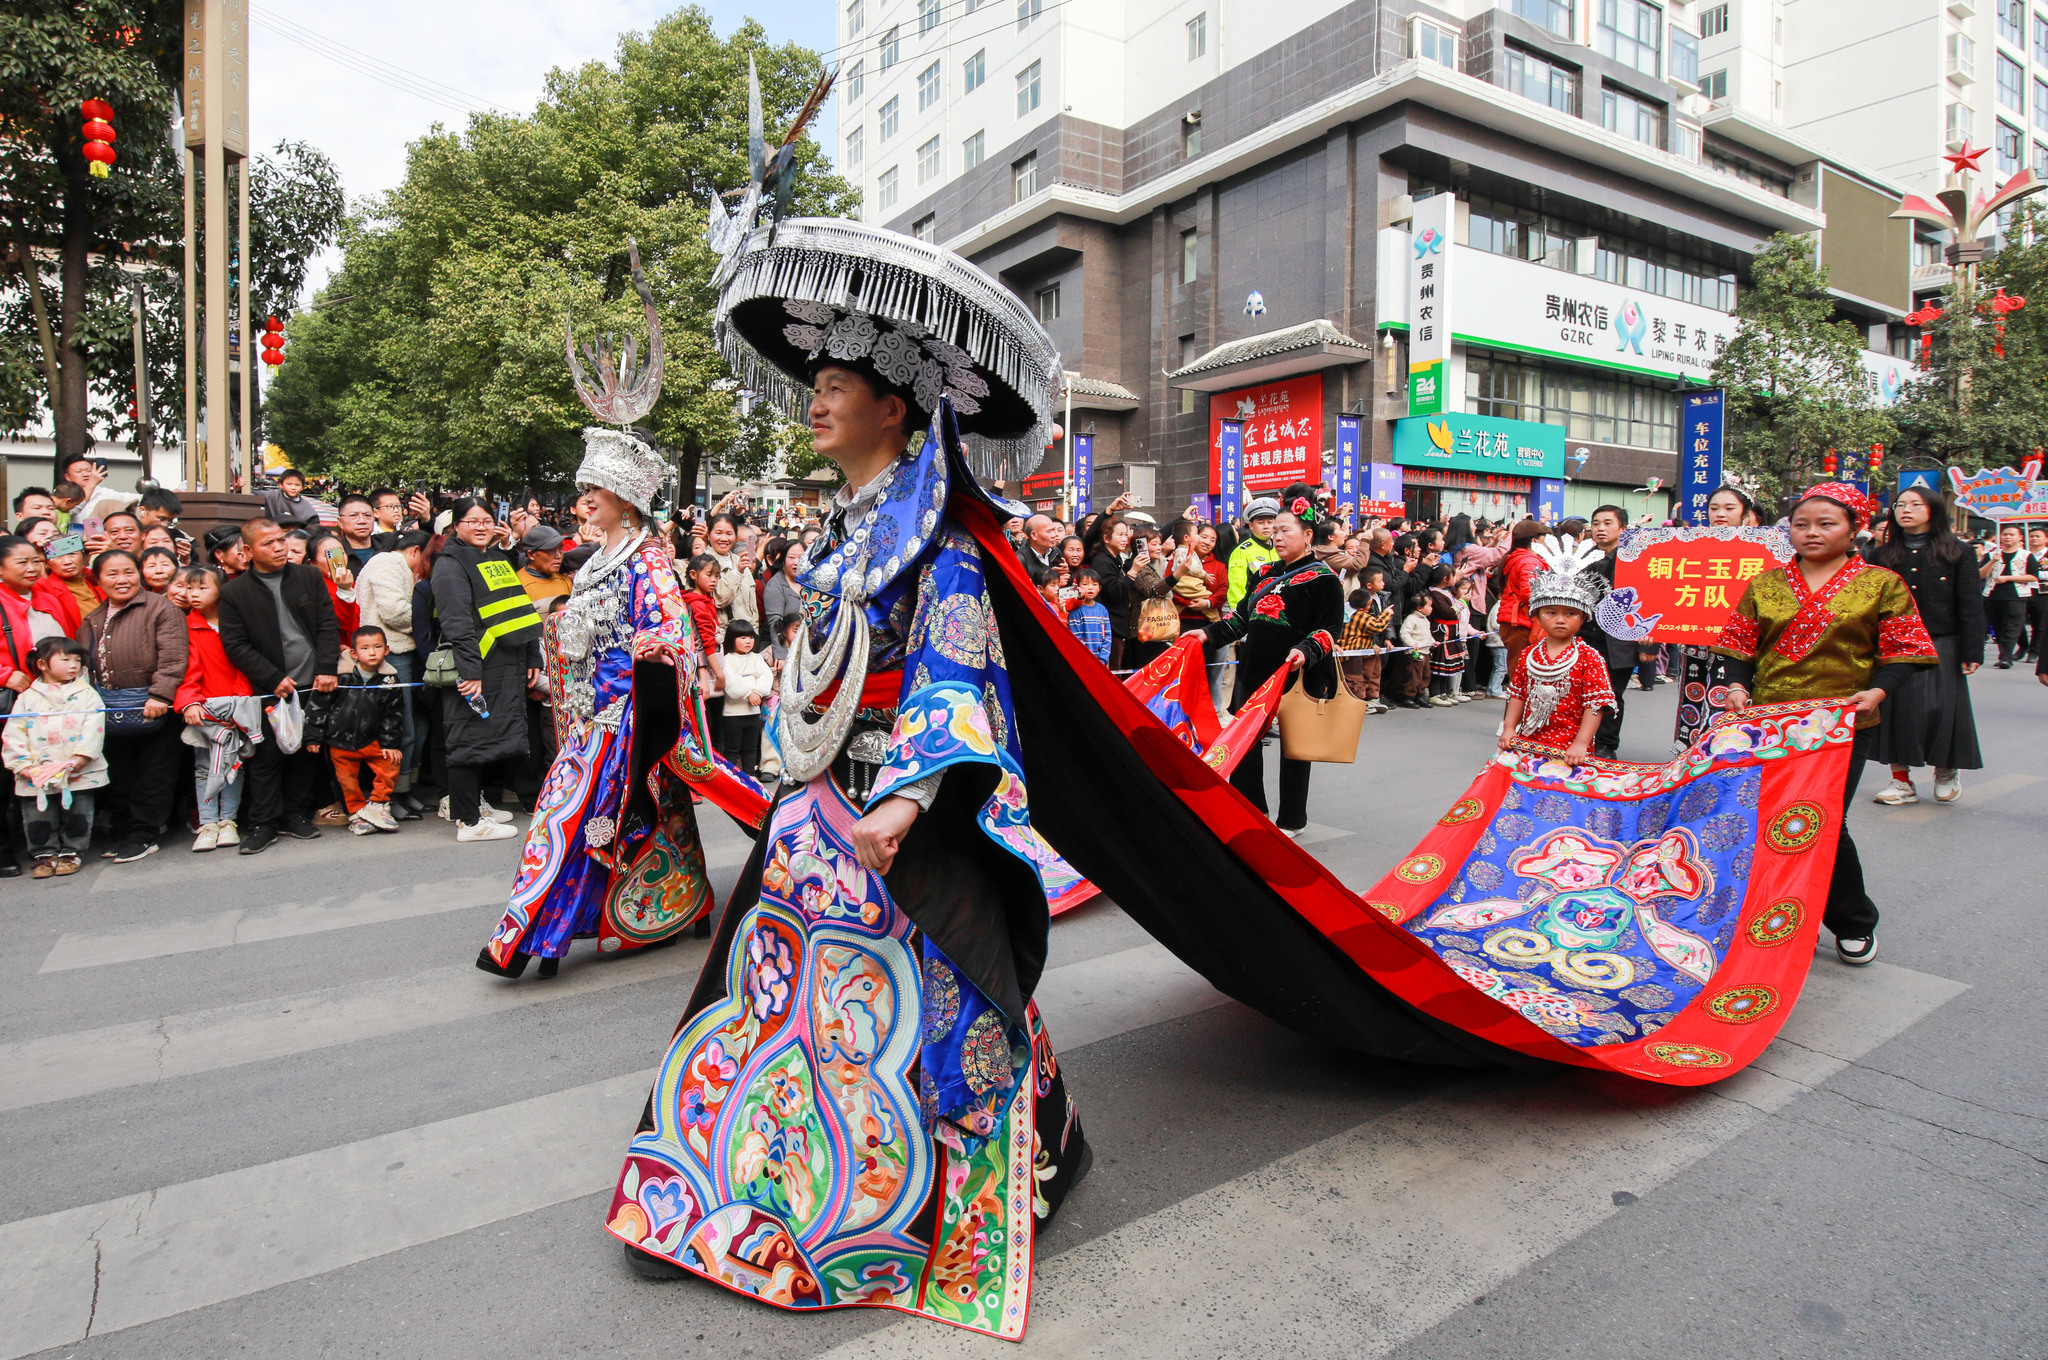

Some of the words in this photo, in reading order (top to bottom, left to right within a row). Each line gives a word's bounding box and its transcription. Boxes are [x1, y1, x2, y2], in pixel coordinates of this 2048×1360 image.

[188, 0, 203, 82] 光之城
[1419, 263, 1435, 342] 贵州农信
[1545, 294, 1609, 331] 贵州农信
[1560, 328, 1594, 346] GZRC
[1651, 348, 1675, 362] LIPING
[1676, 353, 1700, 368] RURAL
[1416, 376, 1436, 393] 24
[1258, 390, 1290, 407] 兰花苑
[1456, 428, 1511, 459] 兰花苑
[1516, 446, 1544, 460] 营销中心
[1693, 421, 1710, 485] 车位充足
[1079, 456, 1087, 497] 城芯公寓
[1226, 445, 1235, 495] 学校很近
[1343, 441, 1352, 494] 城南新核
[1647, 557, 1765, 580] 铜仁玉屏
[1674, 584, 1731, 608] 方队
[1146, 614, 1178, 622] FASHION
